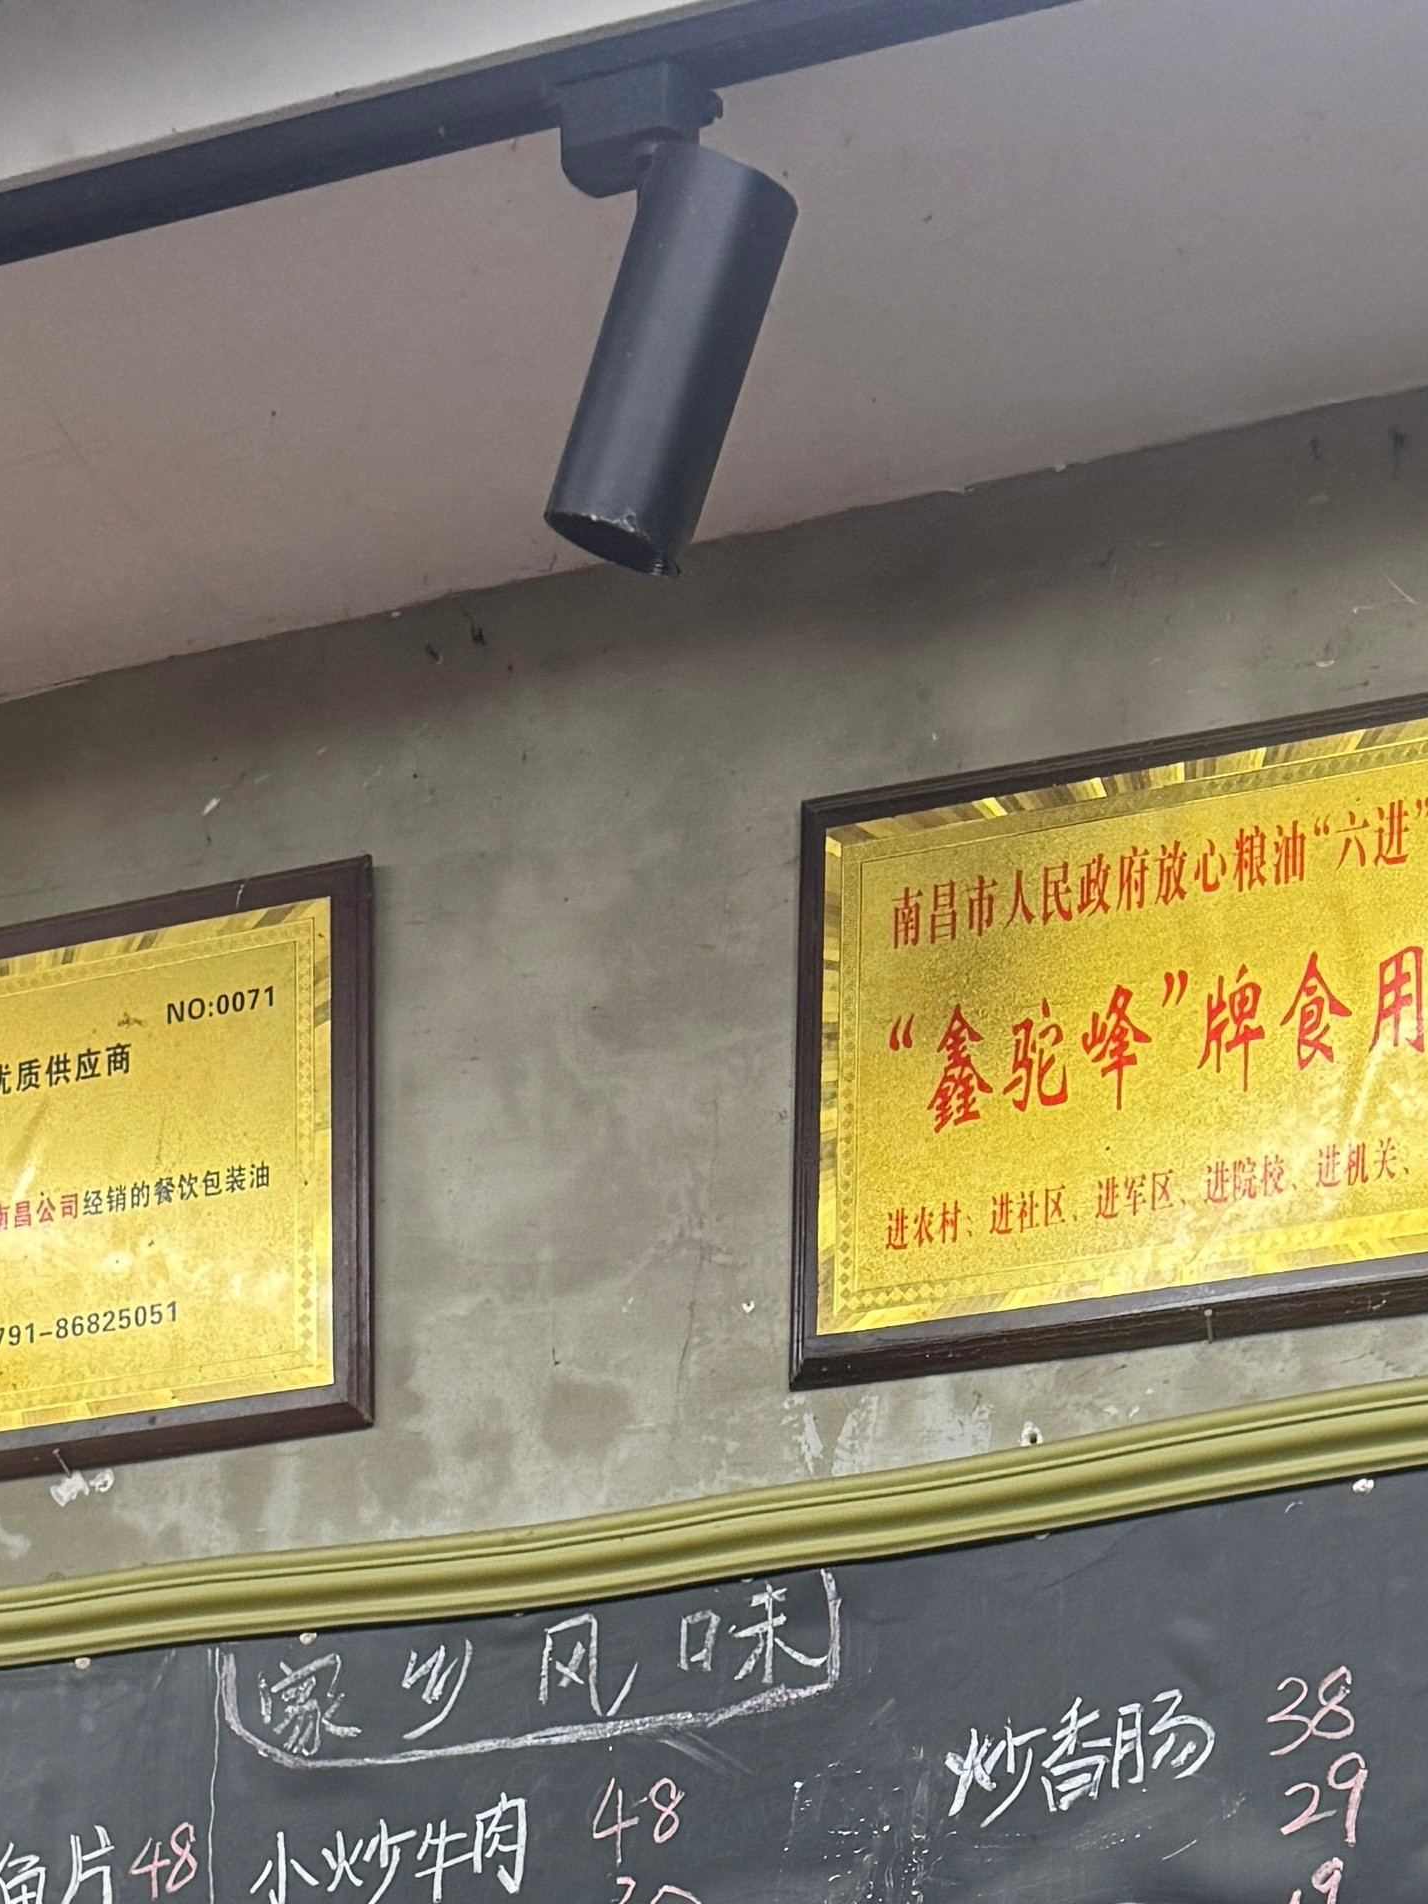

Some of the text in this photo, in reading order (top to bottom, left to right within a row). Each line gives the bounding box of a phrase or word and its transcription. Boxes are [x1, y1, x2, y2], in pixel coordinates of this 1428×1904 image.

[166, 986, 278, 1025] NO:0071
[259, 1583, 830, 1756] 家乡风味
[945, 1667, 1355, 1827] 炒香肠 38
[592, 1776, 684, 1864] 48
[1281, 1752, 1367, 1846] 29
[130, 1822, 197, 1900] 48
